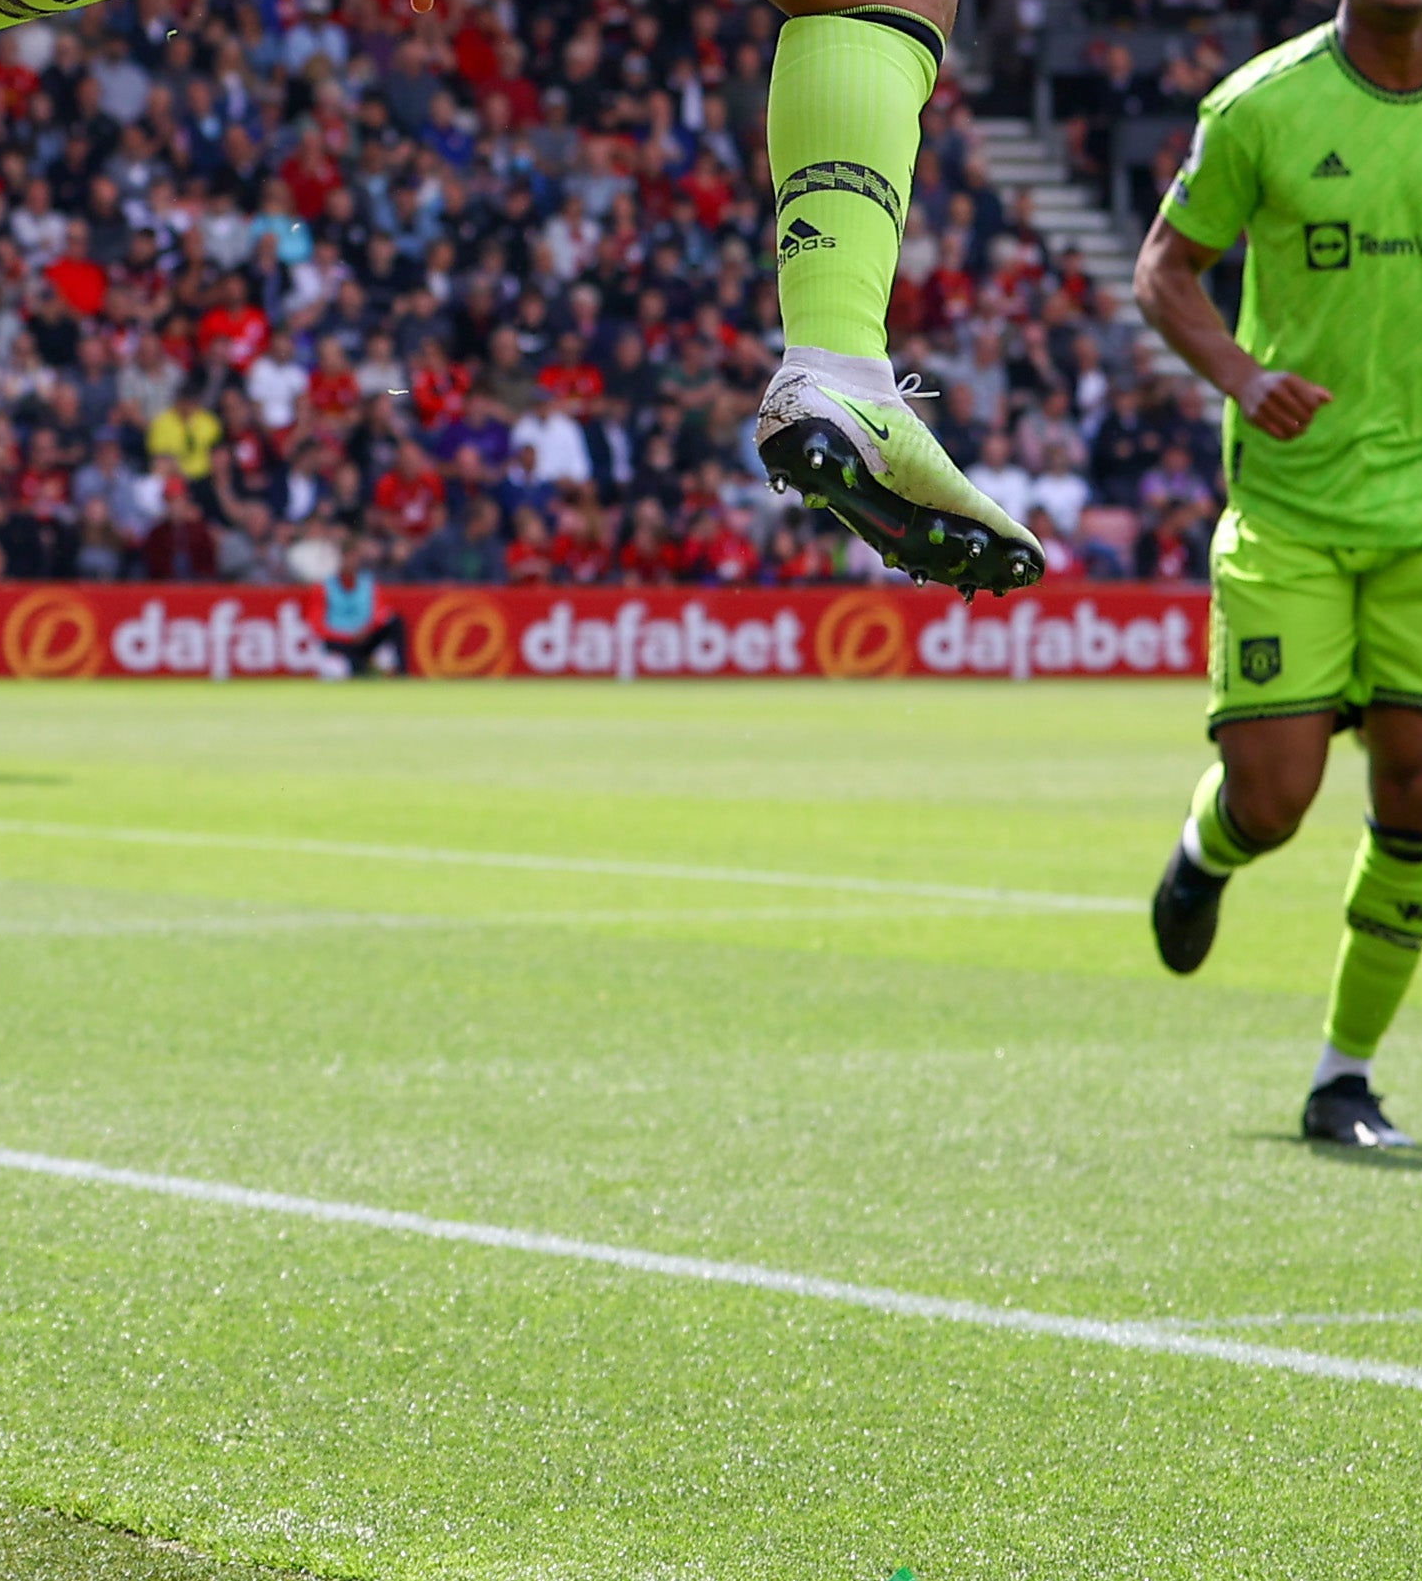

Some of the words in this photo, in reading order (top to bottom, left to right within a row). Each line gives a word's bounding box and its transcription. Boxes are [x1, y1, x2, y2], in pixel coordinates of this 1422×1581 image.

[777, 236, 837, 270] idas
[521, 600, 805, 681] dafabet
[919, 600, 1190, 680] dafabet
